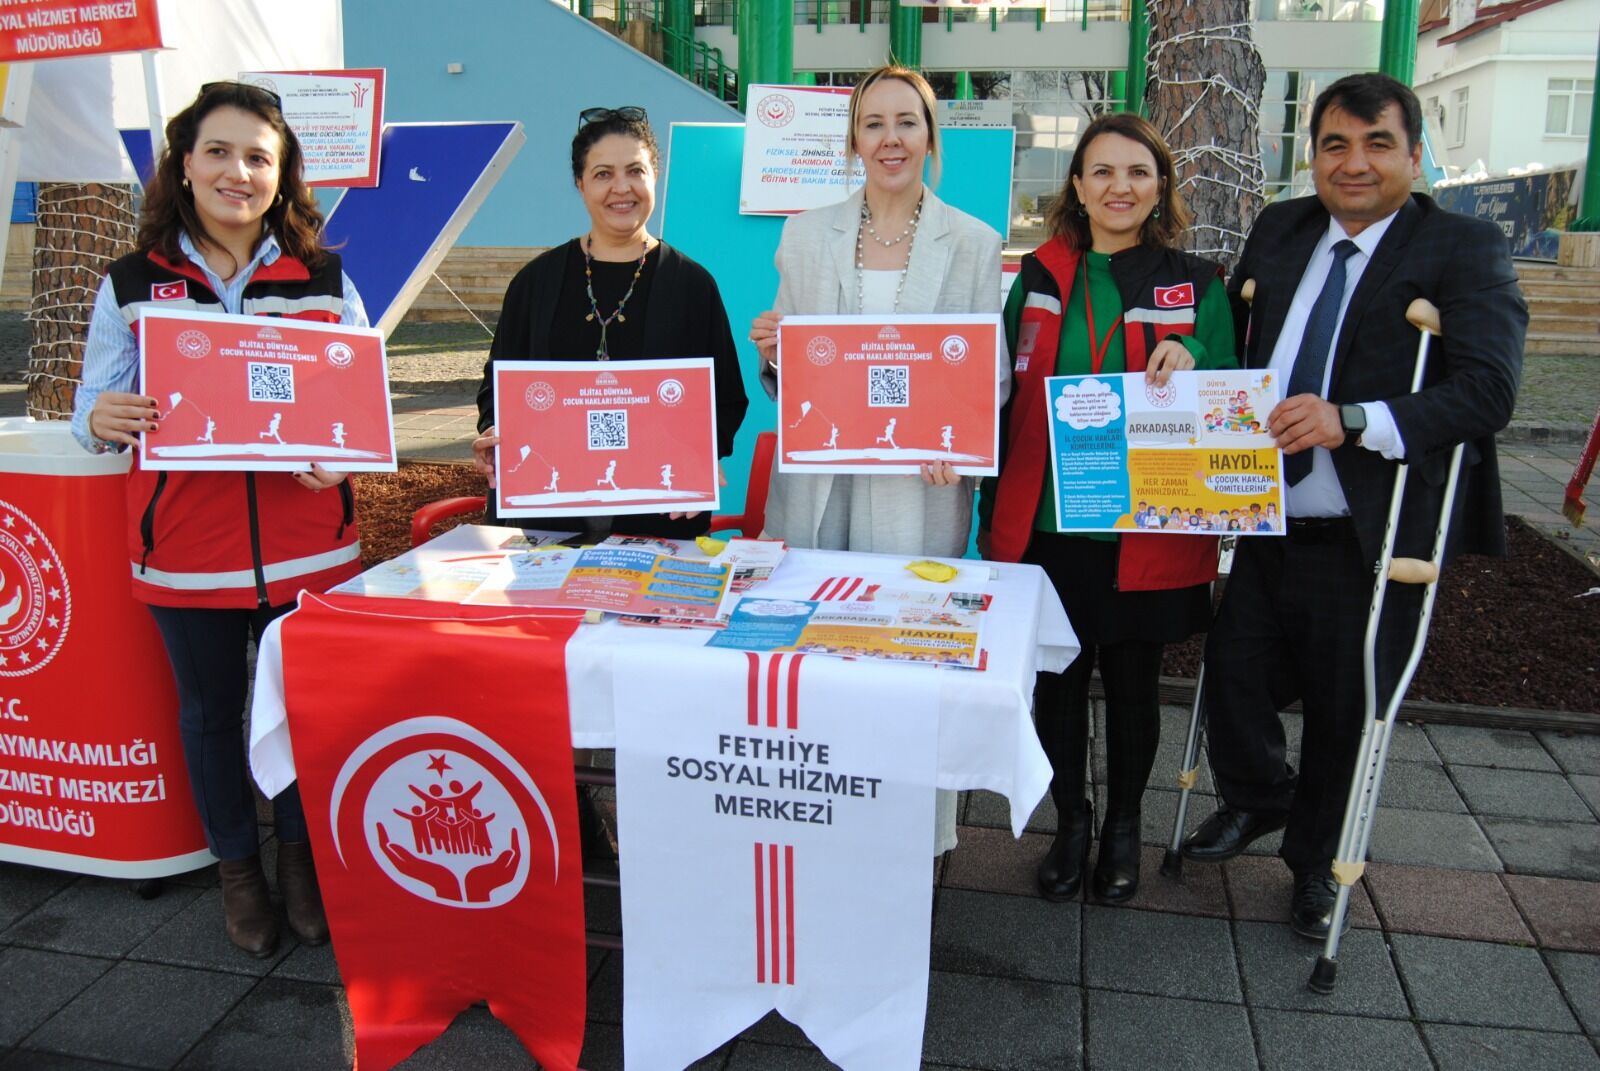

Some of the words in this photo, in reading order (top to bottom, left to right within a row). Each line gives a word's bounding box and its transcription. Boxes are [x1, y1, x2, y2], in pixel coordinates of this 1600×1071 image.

[0, 14, 26, 31] YAL
[27, 8, 77, 28] HİZMET
[80, 1, 137, 23] MERKEZİ
[16, 28, 102, 54] MÜDÜRLÜĞÜ
[801, 148, 836, 158] ZİHİNSEL
[791, 158, 833, 166] BAKIMDAN
[761, 175, 788, 184] EĞİTİM
[240, 340, 264, 350] DİJİTAL
[266, 341, 299, 352] DÜNYADA
[861, 342, 884, 351] DİJİTAL
[886, 341, 915, 351] DÜNYADA
[220, 348, 244, 357] ÇOCUK
[245, 350, 276, 359] HAKLARI
[277, 351, 318, 362] SÖZLEŞMESİ
[844, 352, 866, 361] ÇOCUK
[867, 353, 894, 361] HAKLARI
[895, 351, 932, 362] SÖZLEŞMESİ
[580, 388, 602, 397] DİJİTAL
[604, 387, 632, 396] DÜNYADA
[563, 397, 584, 406] ÇOCUK
[585, 397, 612, 406] HAKLARI
[613, 395, 650, 406] SÖZLEŞMESİ
[1129, 423, 1195, 436] ARKADAŞLAR;
[1210, 450, 1275, 470] HAYDİ...
[1143, 478, 1159, 487] HER
[1161, 478, 1188, 487] ZAMAN
[1206, 475, 1213, 483] İL
[1215, 475, 1240, 485] ÇOCUK
[1242, 474, 1275, 484] HAKLARI
[1214, 484, 1268, 494] KOMİTELERİNE
[0, 534, 19, 552] SYAL
[19, 551, 43, 606] HİZMETLER
[9, 607, 42, 646] BAKANLIĞI
[0, 733, 158, 767] AYMAKAMLIĞI
[719, 734, 829, 765] FETHİYE
[667, 756, 770, 787] SOSYAL
[779, 763, 882, 799] HİZMET
[0, 768, 53, 797] ZMET
[59, 773, 166, 803] MERKEZİ
[715, 793, 832, 825] MERKEZİ
[0, 800, 95, 837] DÜRLÜĞÜ
